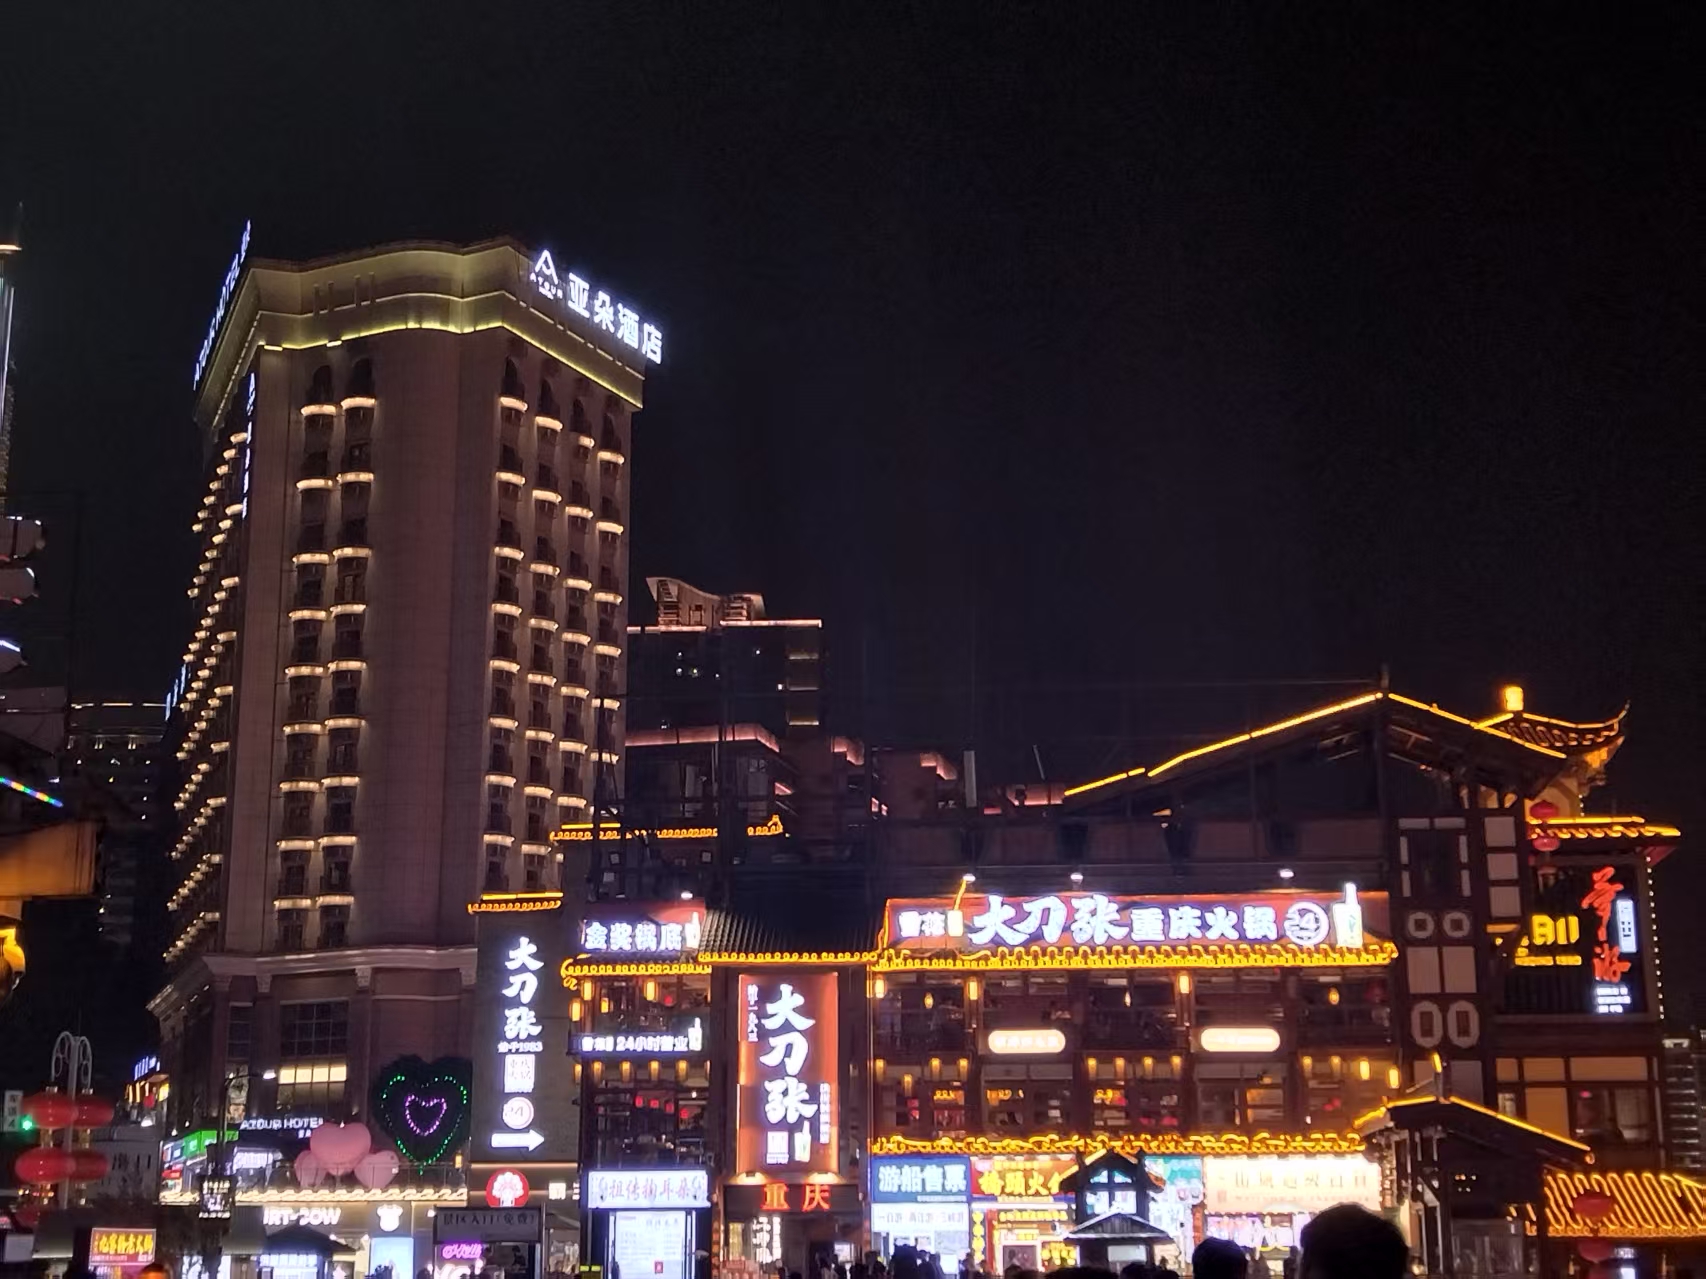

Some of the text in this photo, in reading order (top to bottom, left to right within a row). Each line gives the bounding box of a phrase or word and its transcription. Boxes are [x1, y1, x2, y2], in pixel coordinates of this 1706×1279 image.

[567, 271, 663, 365] 亚朵酒店
[584, 921, 683, 952] 金奖锅底
[967, 893, 1130, 946] 大刀张
[1130, 904, 1278, 942] 重庆火锅
[501, 936, 545, 1040] 大刀张
[759, 983, 819, 1124] 大刀张
[760, 1182, 831, 1213] 重庆
[878, 1164, 967, 1193] 游船售票
